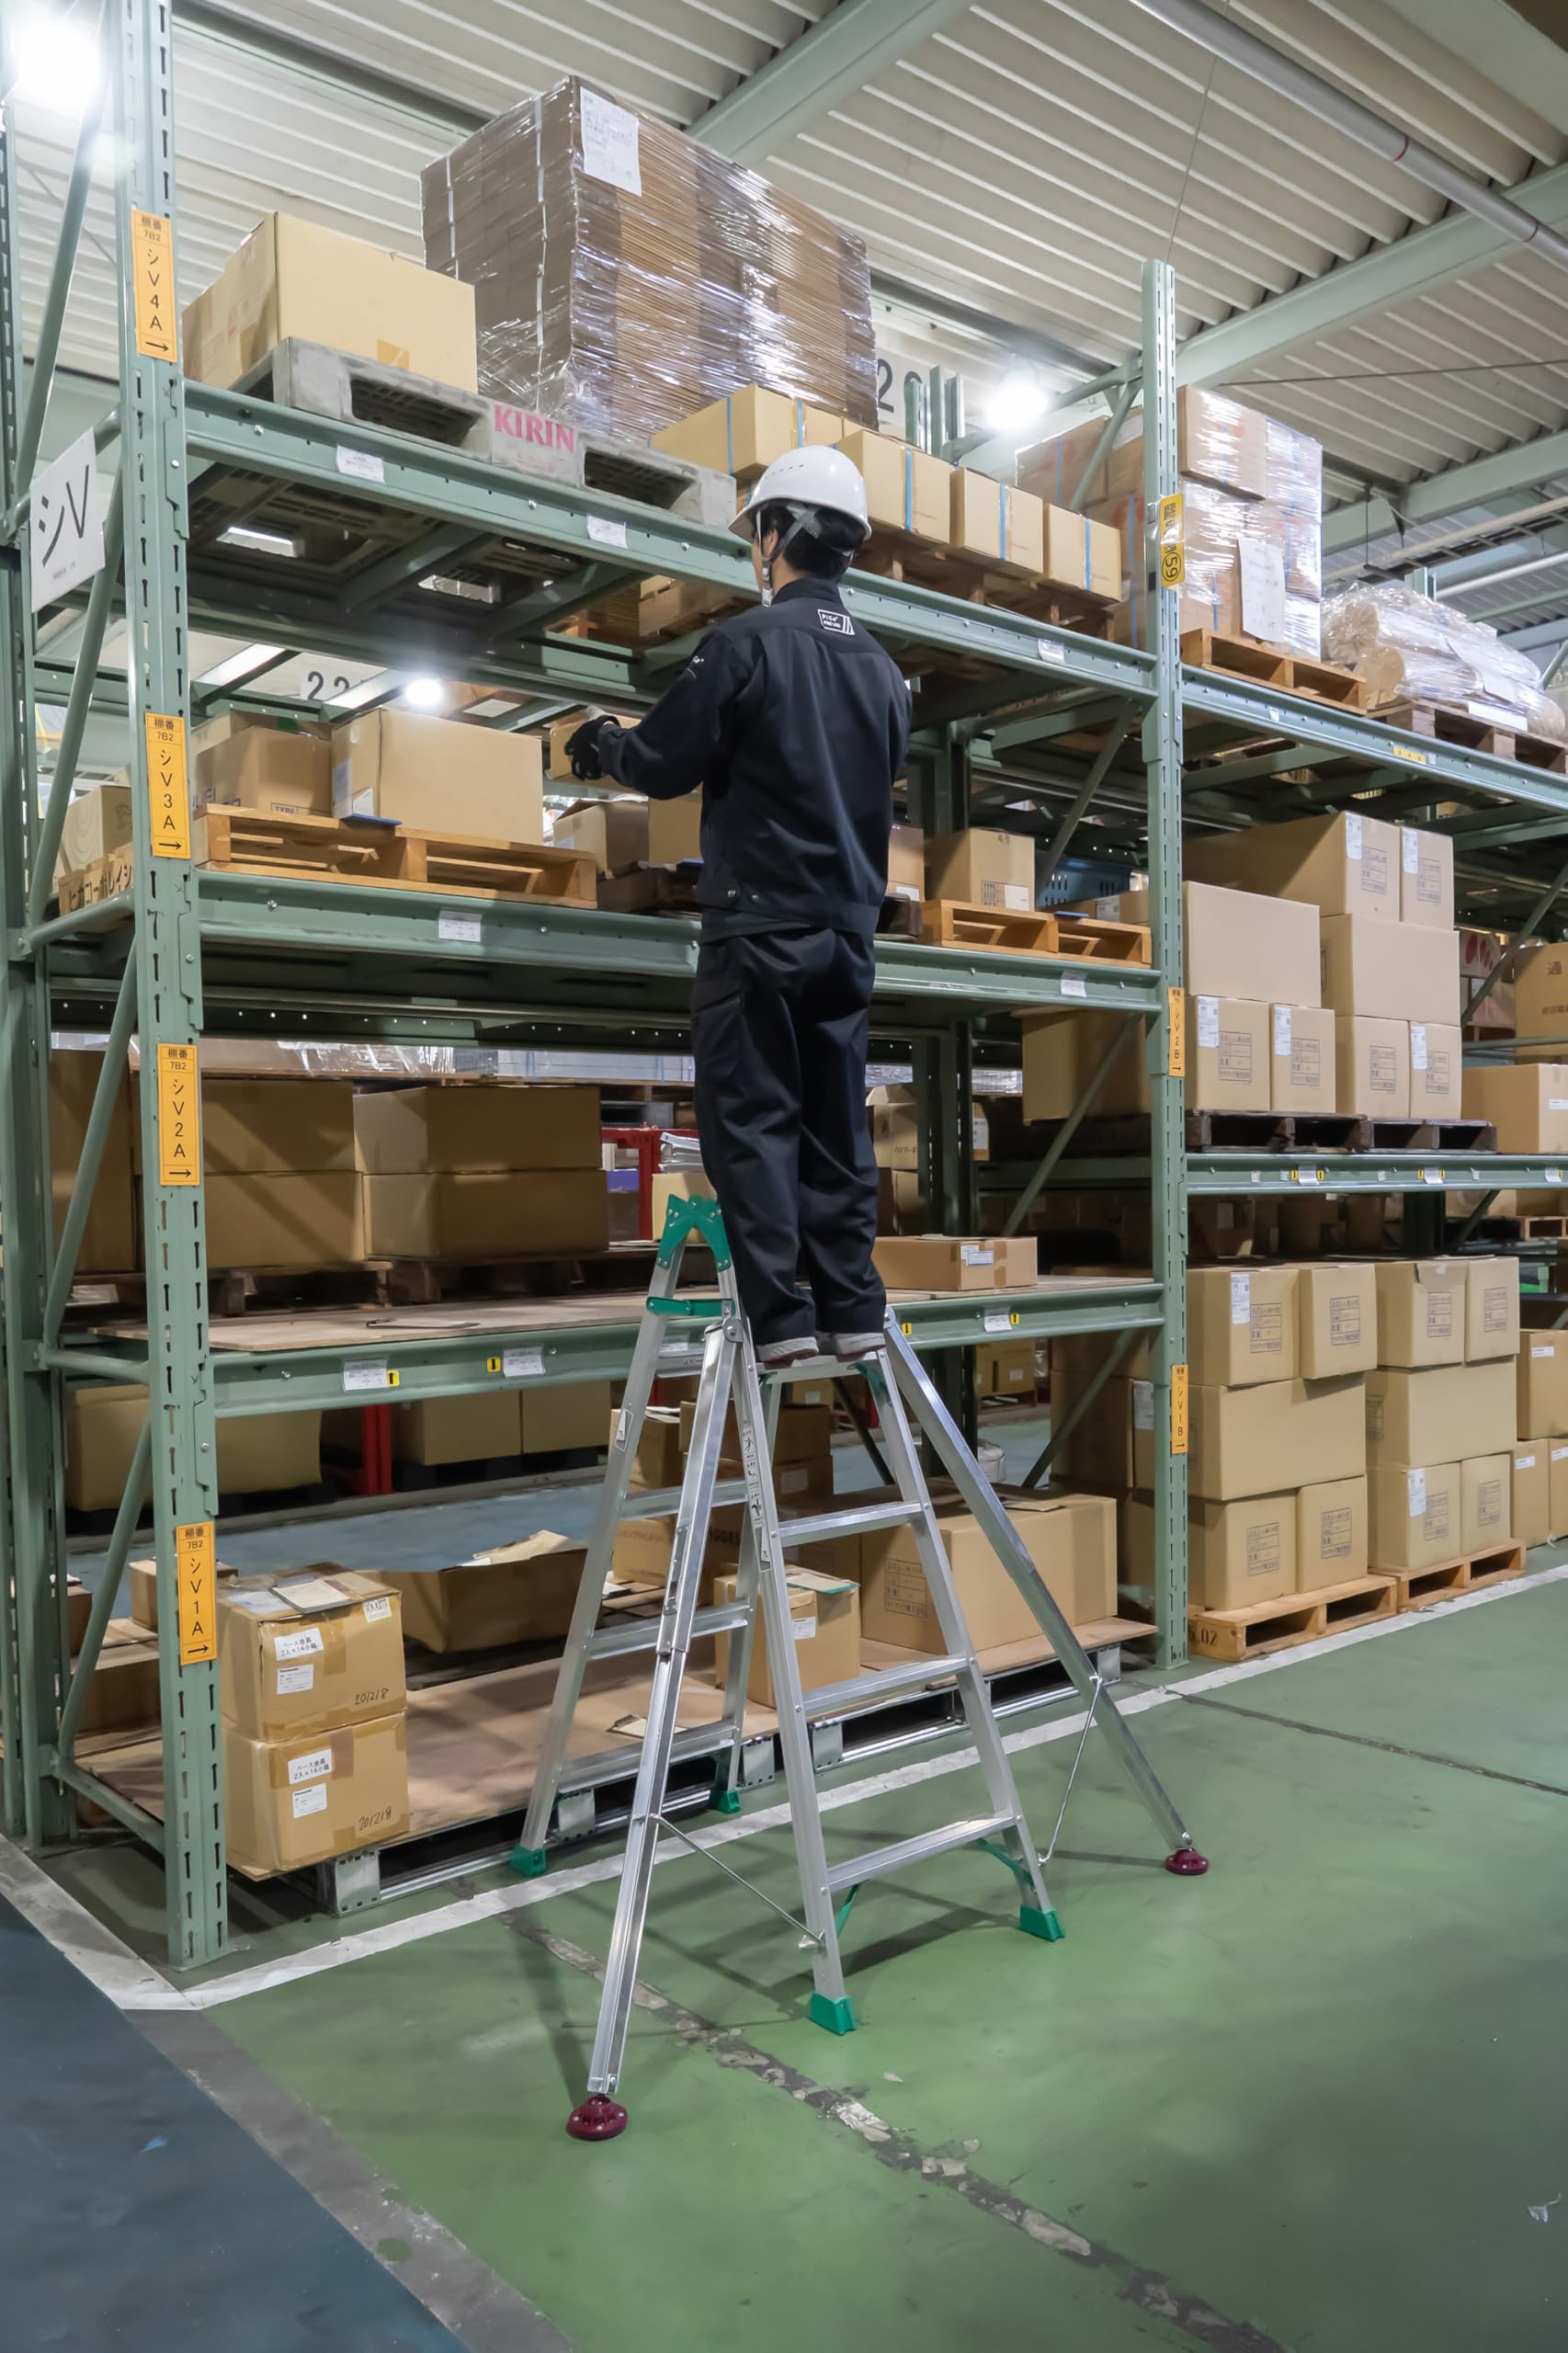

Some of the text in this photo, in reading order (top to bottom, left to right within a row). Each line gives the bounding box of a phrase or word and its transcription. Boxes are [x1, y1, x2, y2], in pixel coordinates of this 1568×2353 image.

[143, 229, 161, 242] 7B2
[147, 248, 163, 331] シV4A
[494, 404, 574, 454] KIRIN
[39, 463, 89, 567] シV
[1165, 556, 1178, 579] 59
[154, 718, 175, 731] 棚番
[156, 731, 174, 742] 7B2
[160, 749, 176, 830] シV3A
[167, 1048, 187, 1059] 棚番
[170, 1061, 187, 1070] 7B2
[173, 1079, 186, 1158] シV2A
[185, 1528, 204, 1539] 棚番
[187, 1540, 203, 1550] 7B2
[190, 1558, 204, 1636] シV1A
